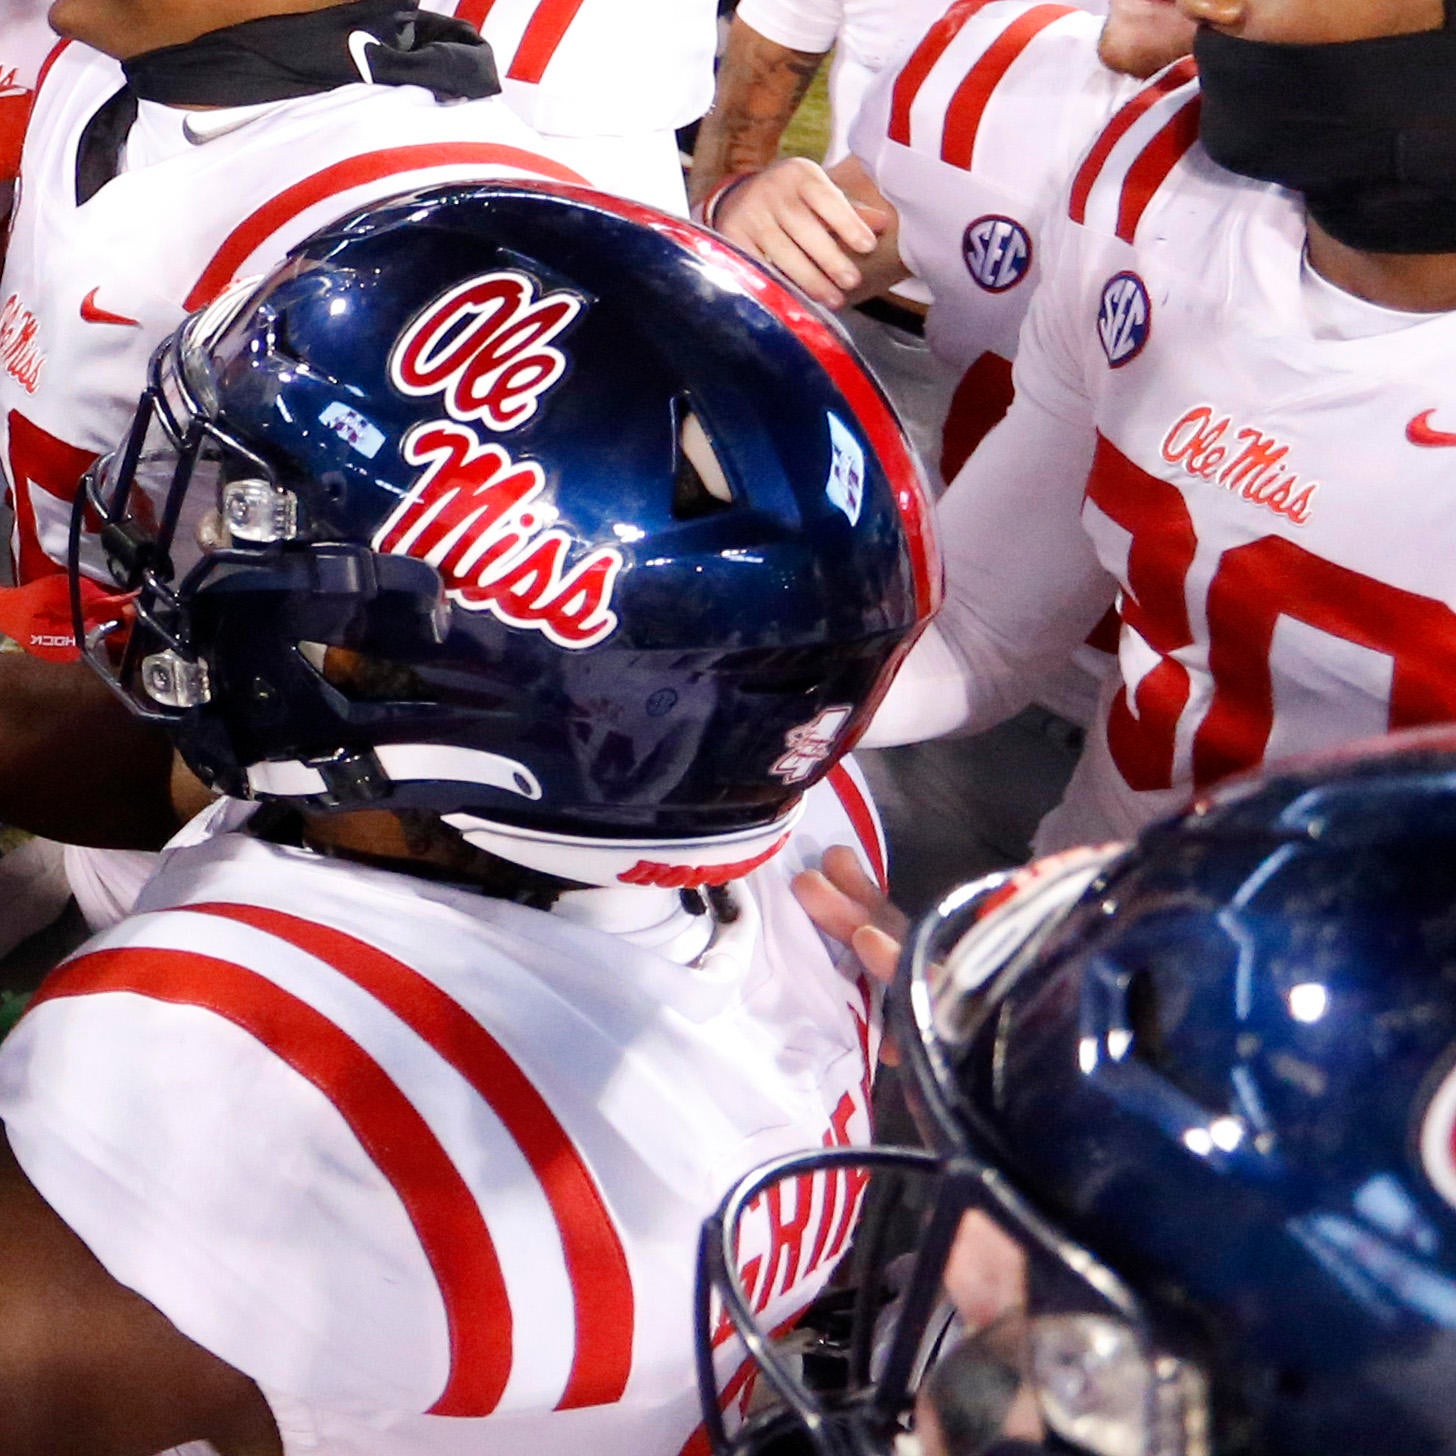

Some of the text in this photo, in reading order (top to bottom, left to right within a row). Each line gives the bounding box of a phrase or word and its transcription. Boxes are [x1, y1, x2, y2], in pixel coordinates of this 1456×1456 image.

[966, 218, 1031, 289] SEC
[389, 272, 582, 432] Ole
[1098, 277, 1148, 363] SEC
[1162, 405, 1319, 525] Ole Miss
[374, 419, 624, 649] Miss
[30, 634, 90, 647] HOCK
